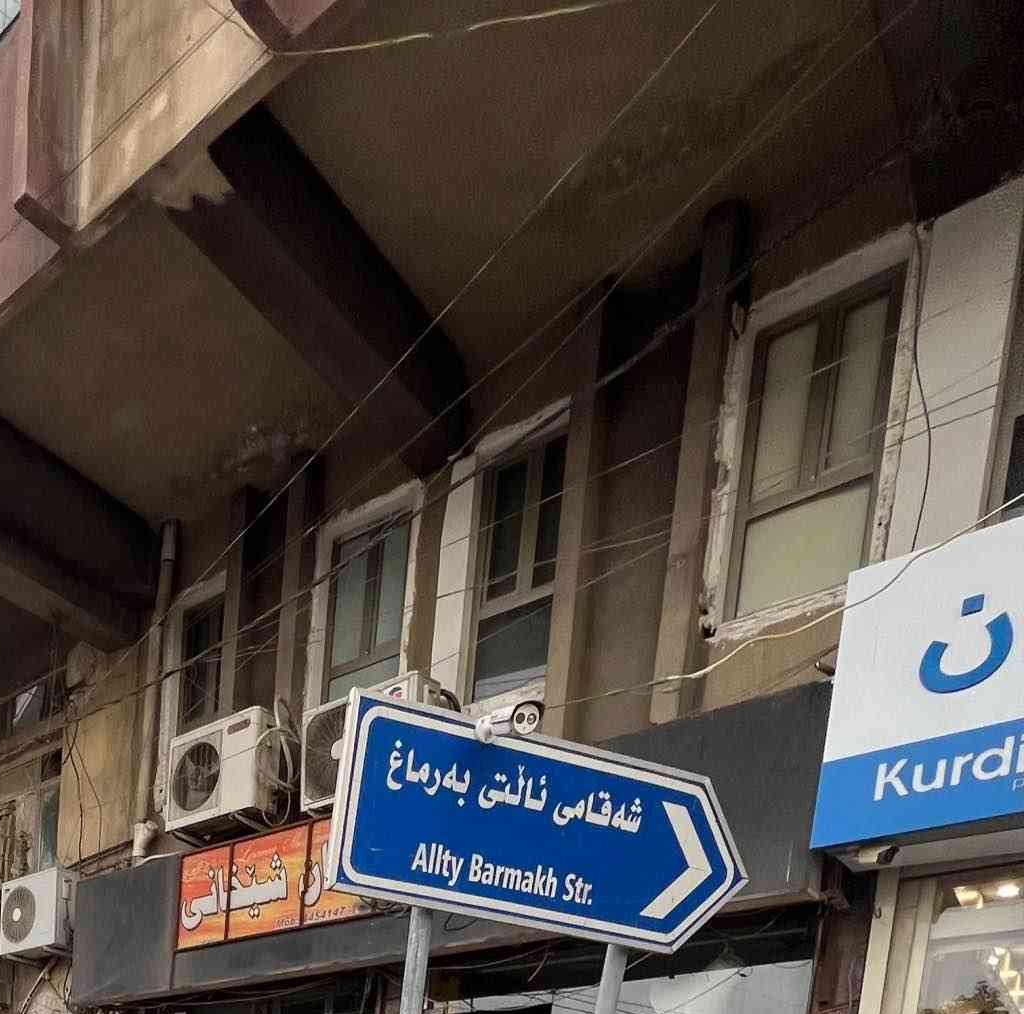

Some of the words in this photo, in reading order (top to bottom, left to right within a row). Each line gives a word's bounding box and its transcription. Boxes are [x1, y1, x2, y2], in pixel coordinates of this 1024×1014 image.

[386, 739, 472, 808] بەرماغ
[552, 790, 644, 834] شەقامی
[411, 842, 465, 887] Allty
[469, 853, 558, 899] Barmakh
[562, 873, 594, 906] Str.
